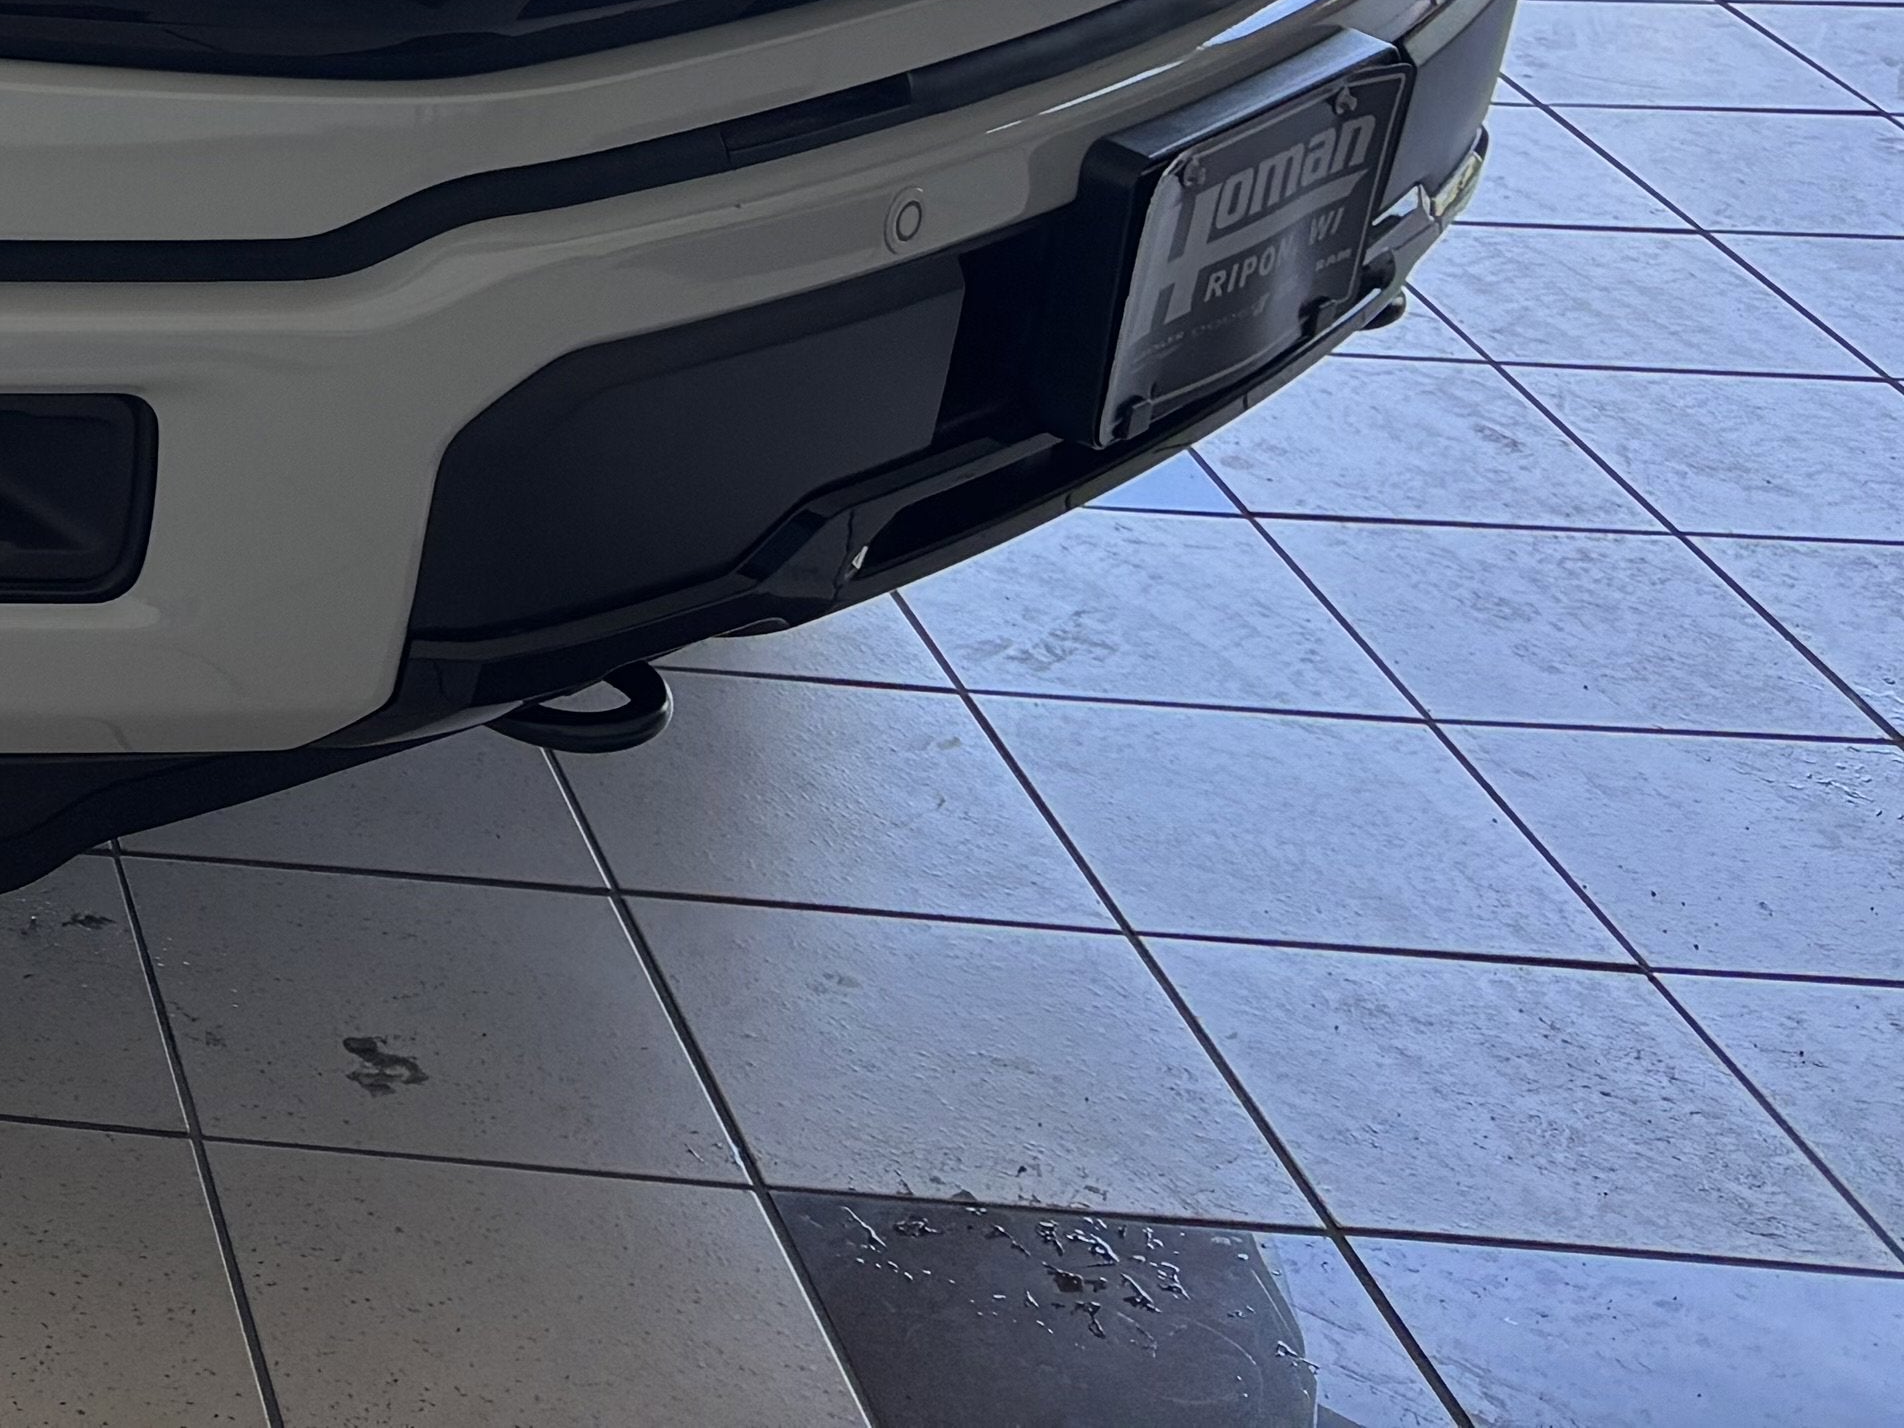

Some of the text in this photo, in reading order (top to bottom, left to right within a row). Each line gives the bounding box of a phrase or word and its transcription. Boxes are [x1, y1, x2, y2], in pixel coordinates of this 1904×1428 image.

[1131, 116, 1376, 342] Homan
[1203, 207, 1346, 304] RIPON WI
